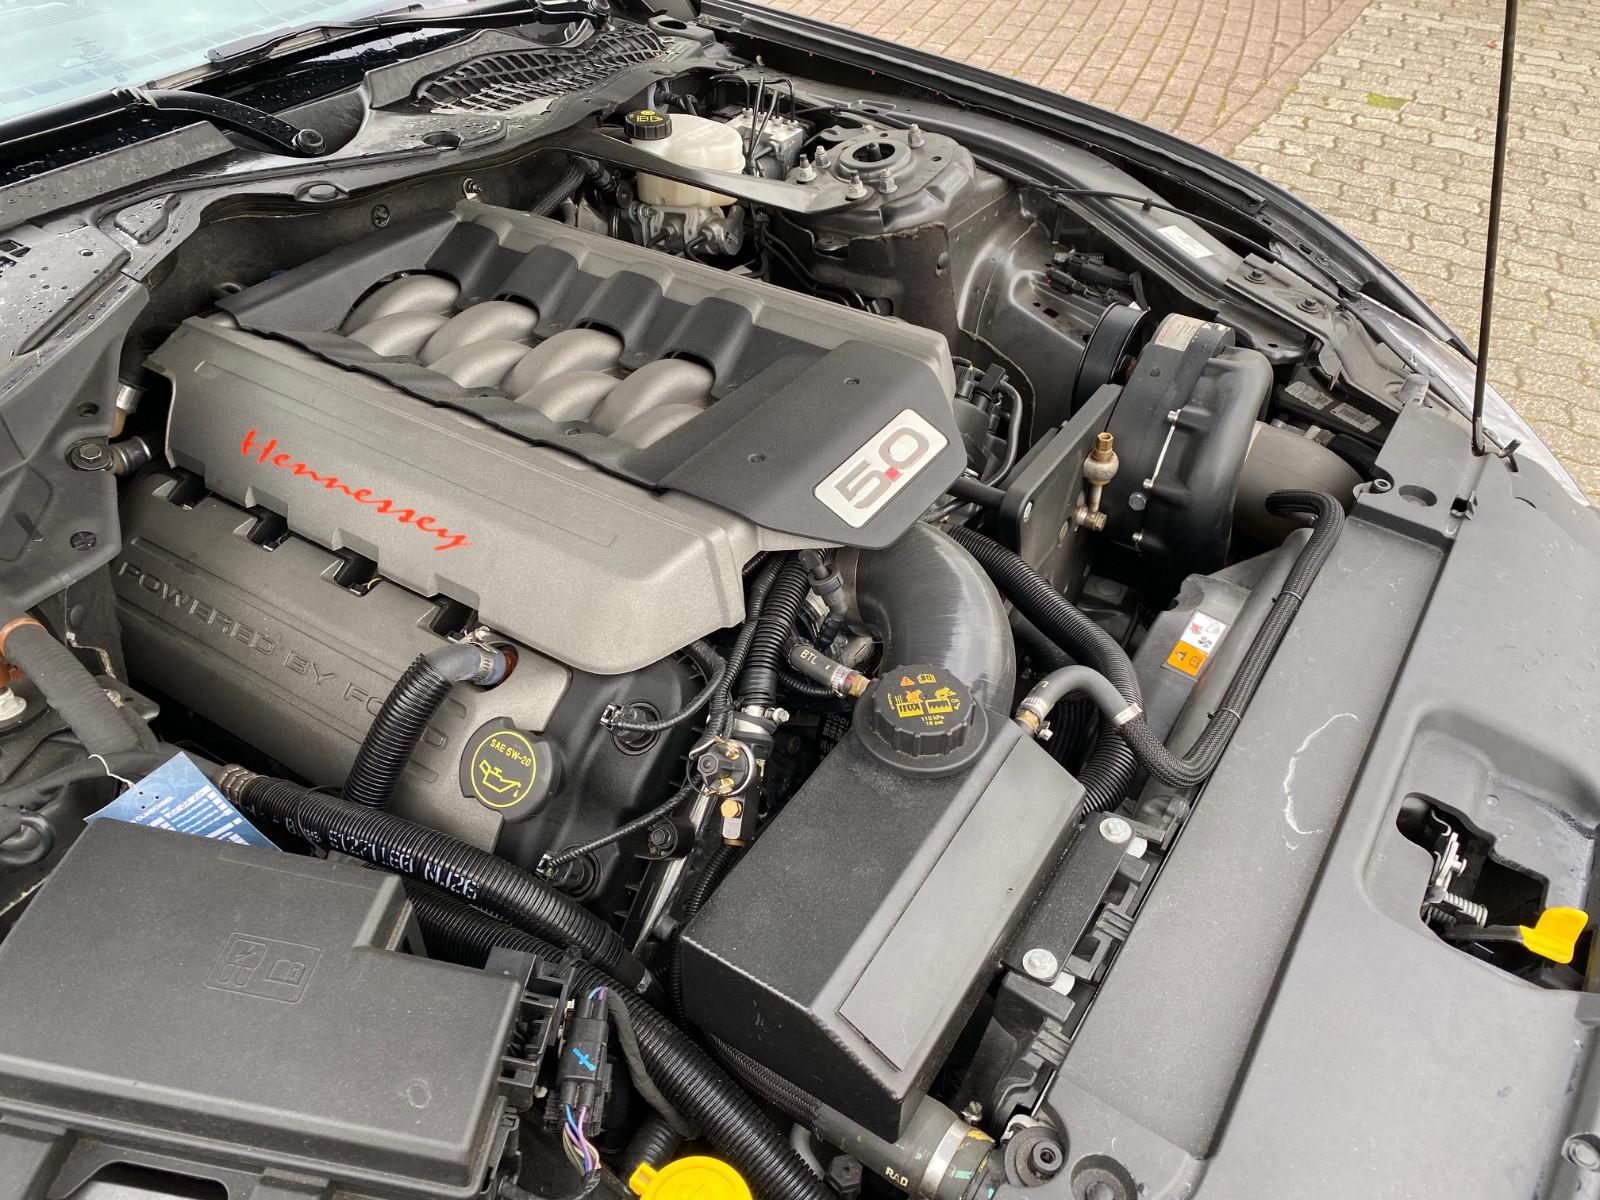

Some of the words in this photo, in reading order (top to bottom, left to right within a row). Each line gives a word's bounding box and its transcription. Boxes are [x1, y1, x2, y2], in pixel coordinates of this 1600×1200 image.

[240, 428, 474, 551] Hennessey
[835, 427, 930, 510] 5.0
[118, 561, 278, 657] POWERED
[281, 650, 337, 686] BY
[800, 649, 818, 665] BTL
[490, 739, 506, 753] SAE
[506, 747, 532, 767] 5W-20
[885, 1166, 908, 1188] RAD
